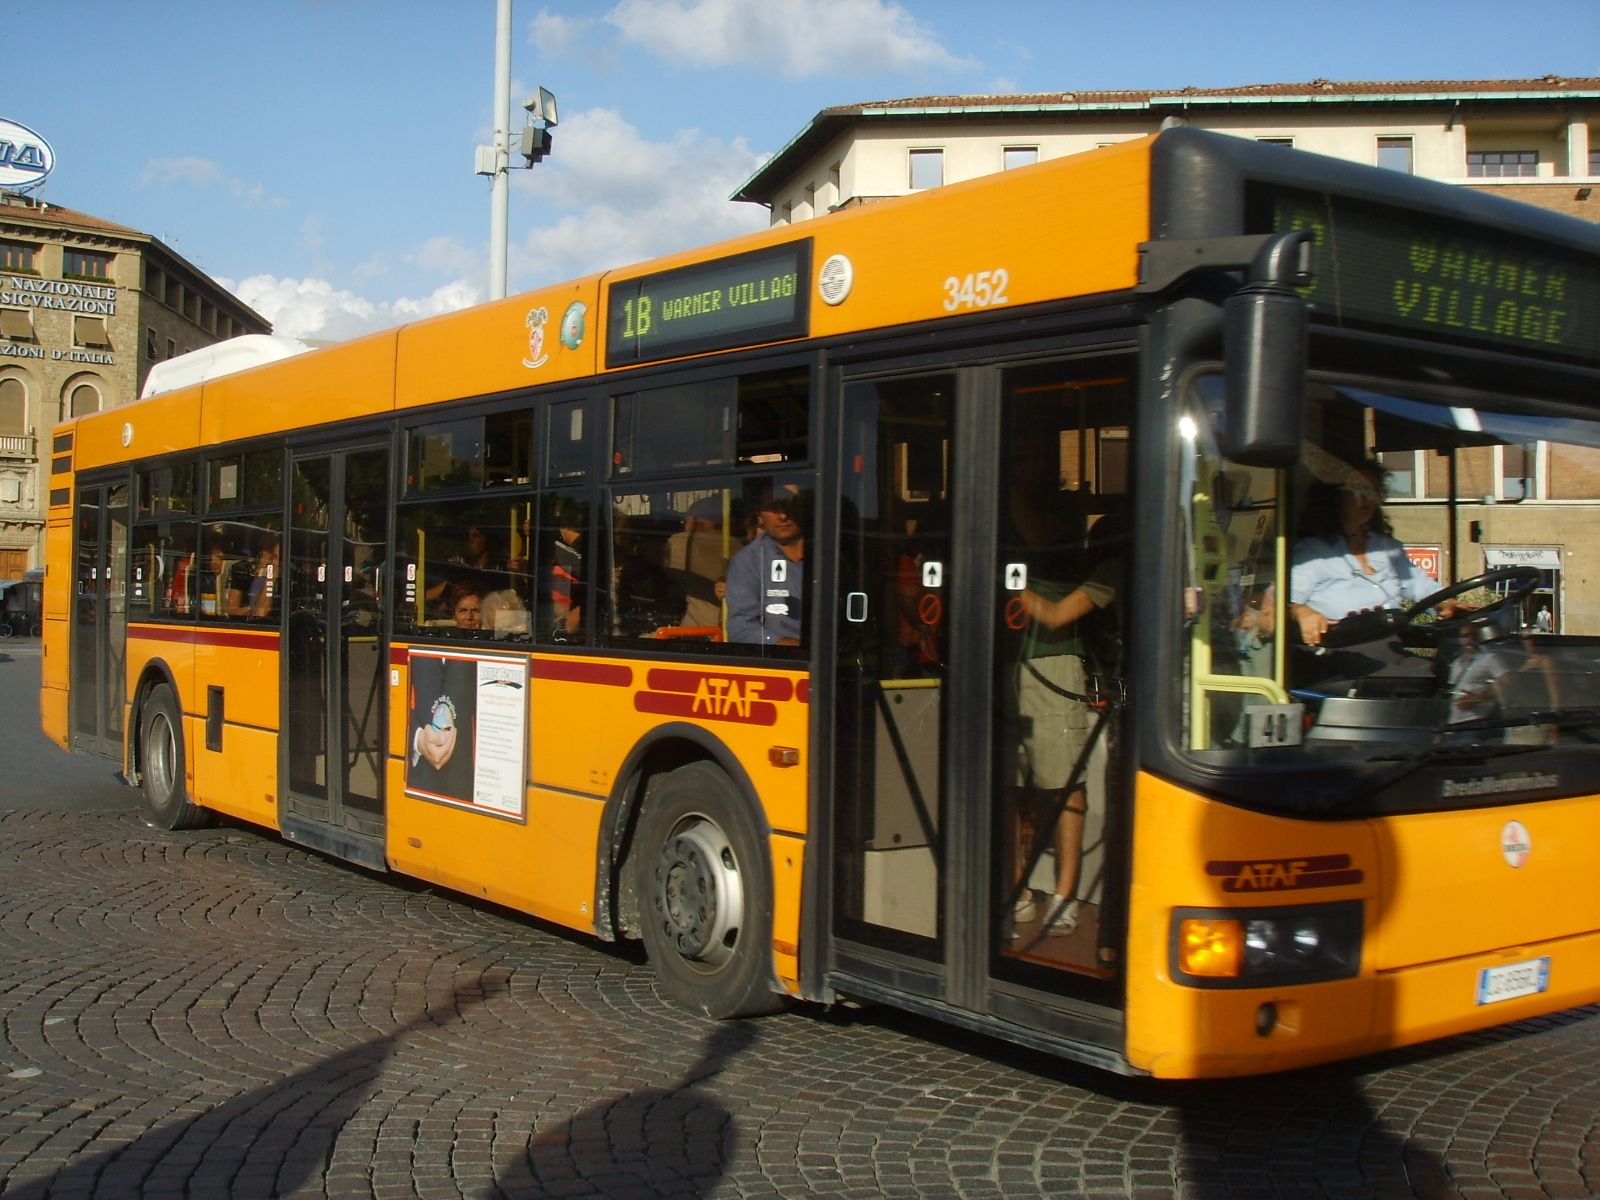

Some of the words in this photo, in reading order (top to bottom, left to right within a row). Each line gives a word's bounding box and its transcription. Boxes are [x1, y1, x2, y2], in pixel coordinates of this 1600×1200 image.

[11, 277, 117, 301] NAZIONALE
[943, 268, 1009, 312] 3452
[623, 296, 653, 339] 1B
[662, 290, 723, 321] WARNER
[1393, 280, 1568, 344] VILLAGE
[0, 343, 44, 359] ZIONI
[692, 678, 766, 718] ATAF
[1235, 861, 1308, 889] ATAF
